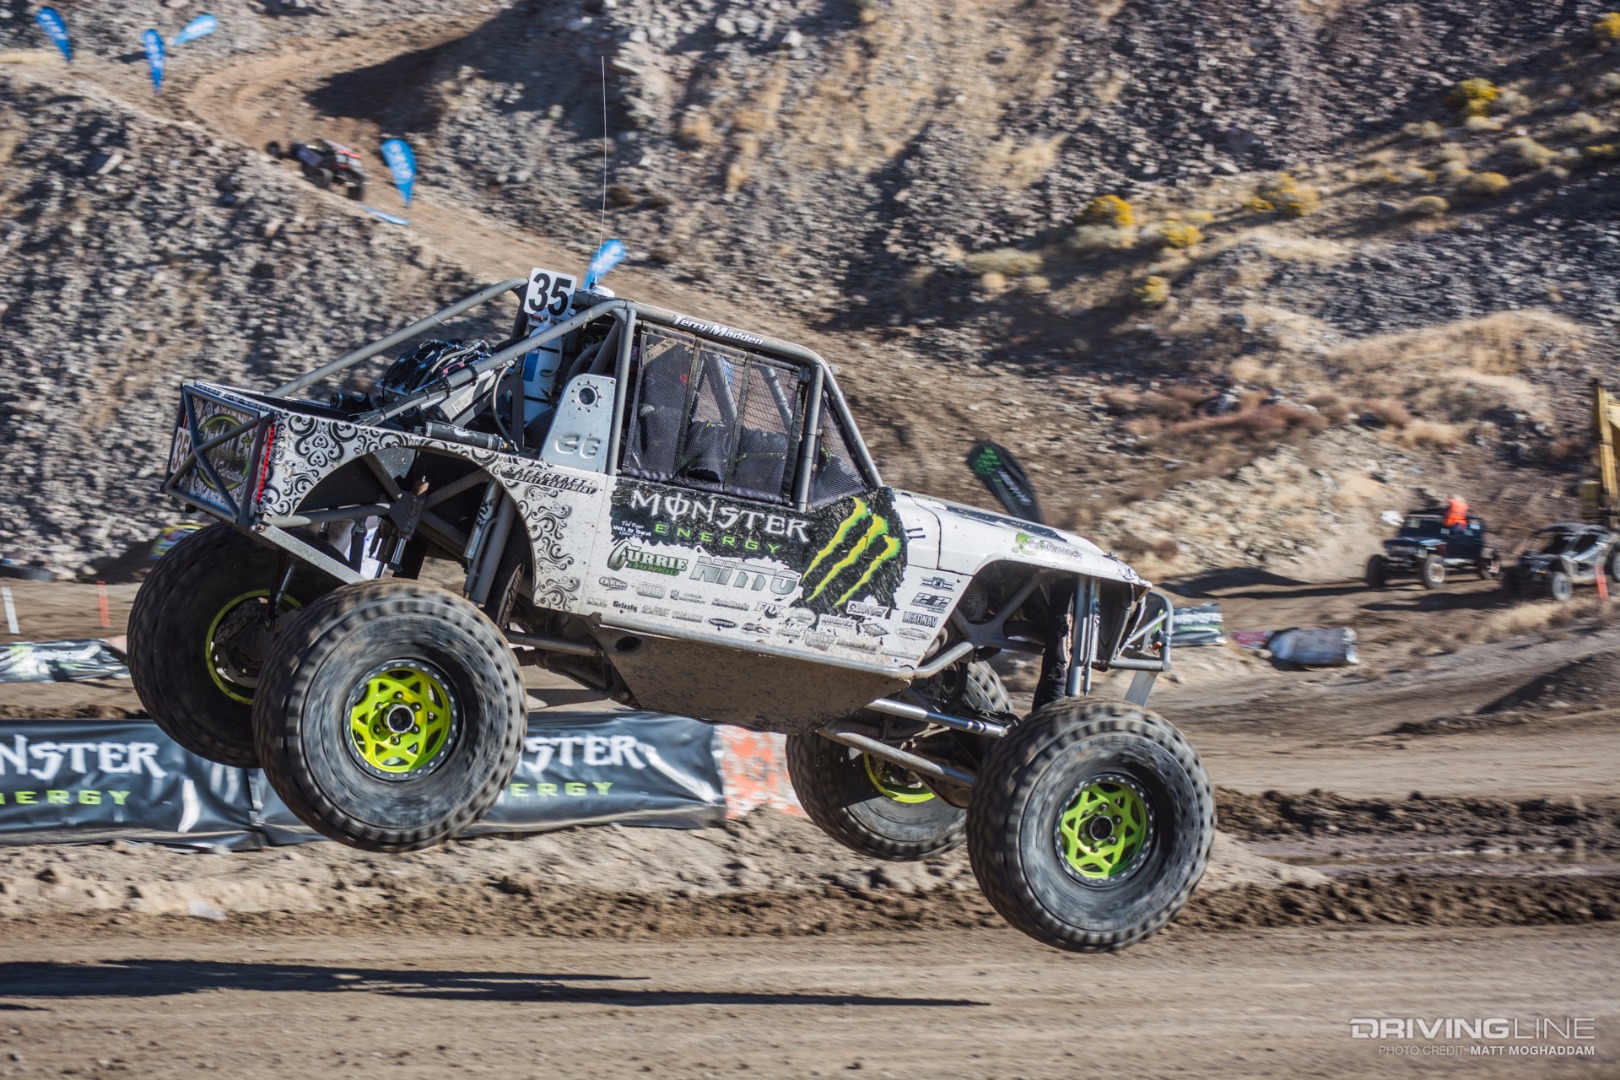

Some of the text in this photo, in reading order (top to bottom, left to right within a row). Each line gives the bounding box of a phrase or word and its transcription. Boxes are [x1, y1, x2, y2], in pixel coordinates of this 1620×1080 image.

[528, 272, 572, 316] 35
[672, 314, 764, 346] Terry Madden
[506, 466, 588, 486] SAFECRAFT
[630, 489, 811, 543] MONSTER
[655, 522, 780, 554] ENERGY
[607, 540, 688, 573] CURRIE
[689, 555, 799, 596] NITTO
[612, 600, 638, 613] Grizzly
[902, 611, 939, 628] LEADNAV
[0, 733, 168, 781] NSTER
[519, 733, 646, 773] STER
[510, 781, 613, 798] ERGY
